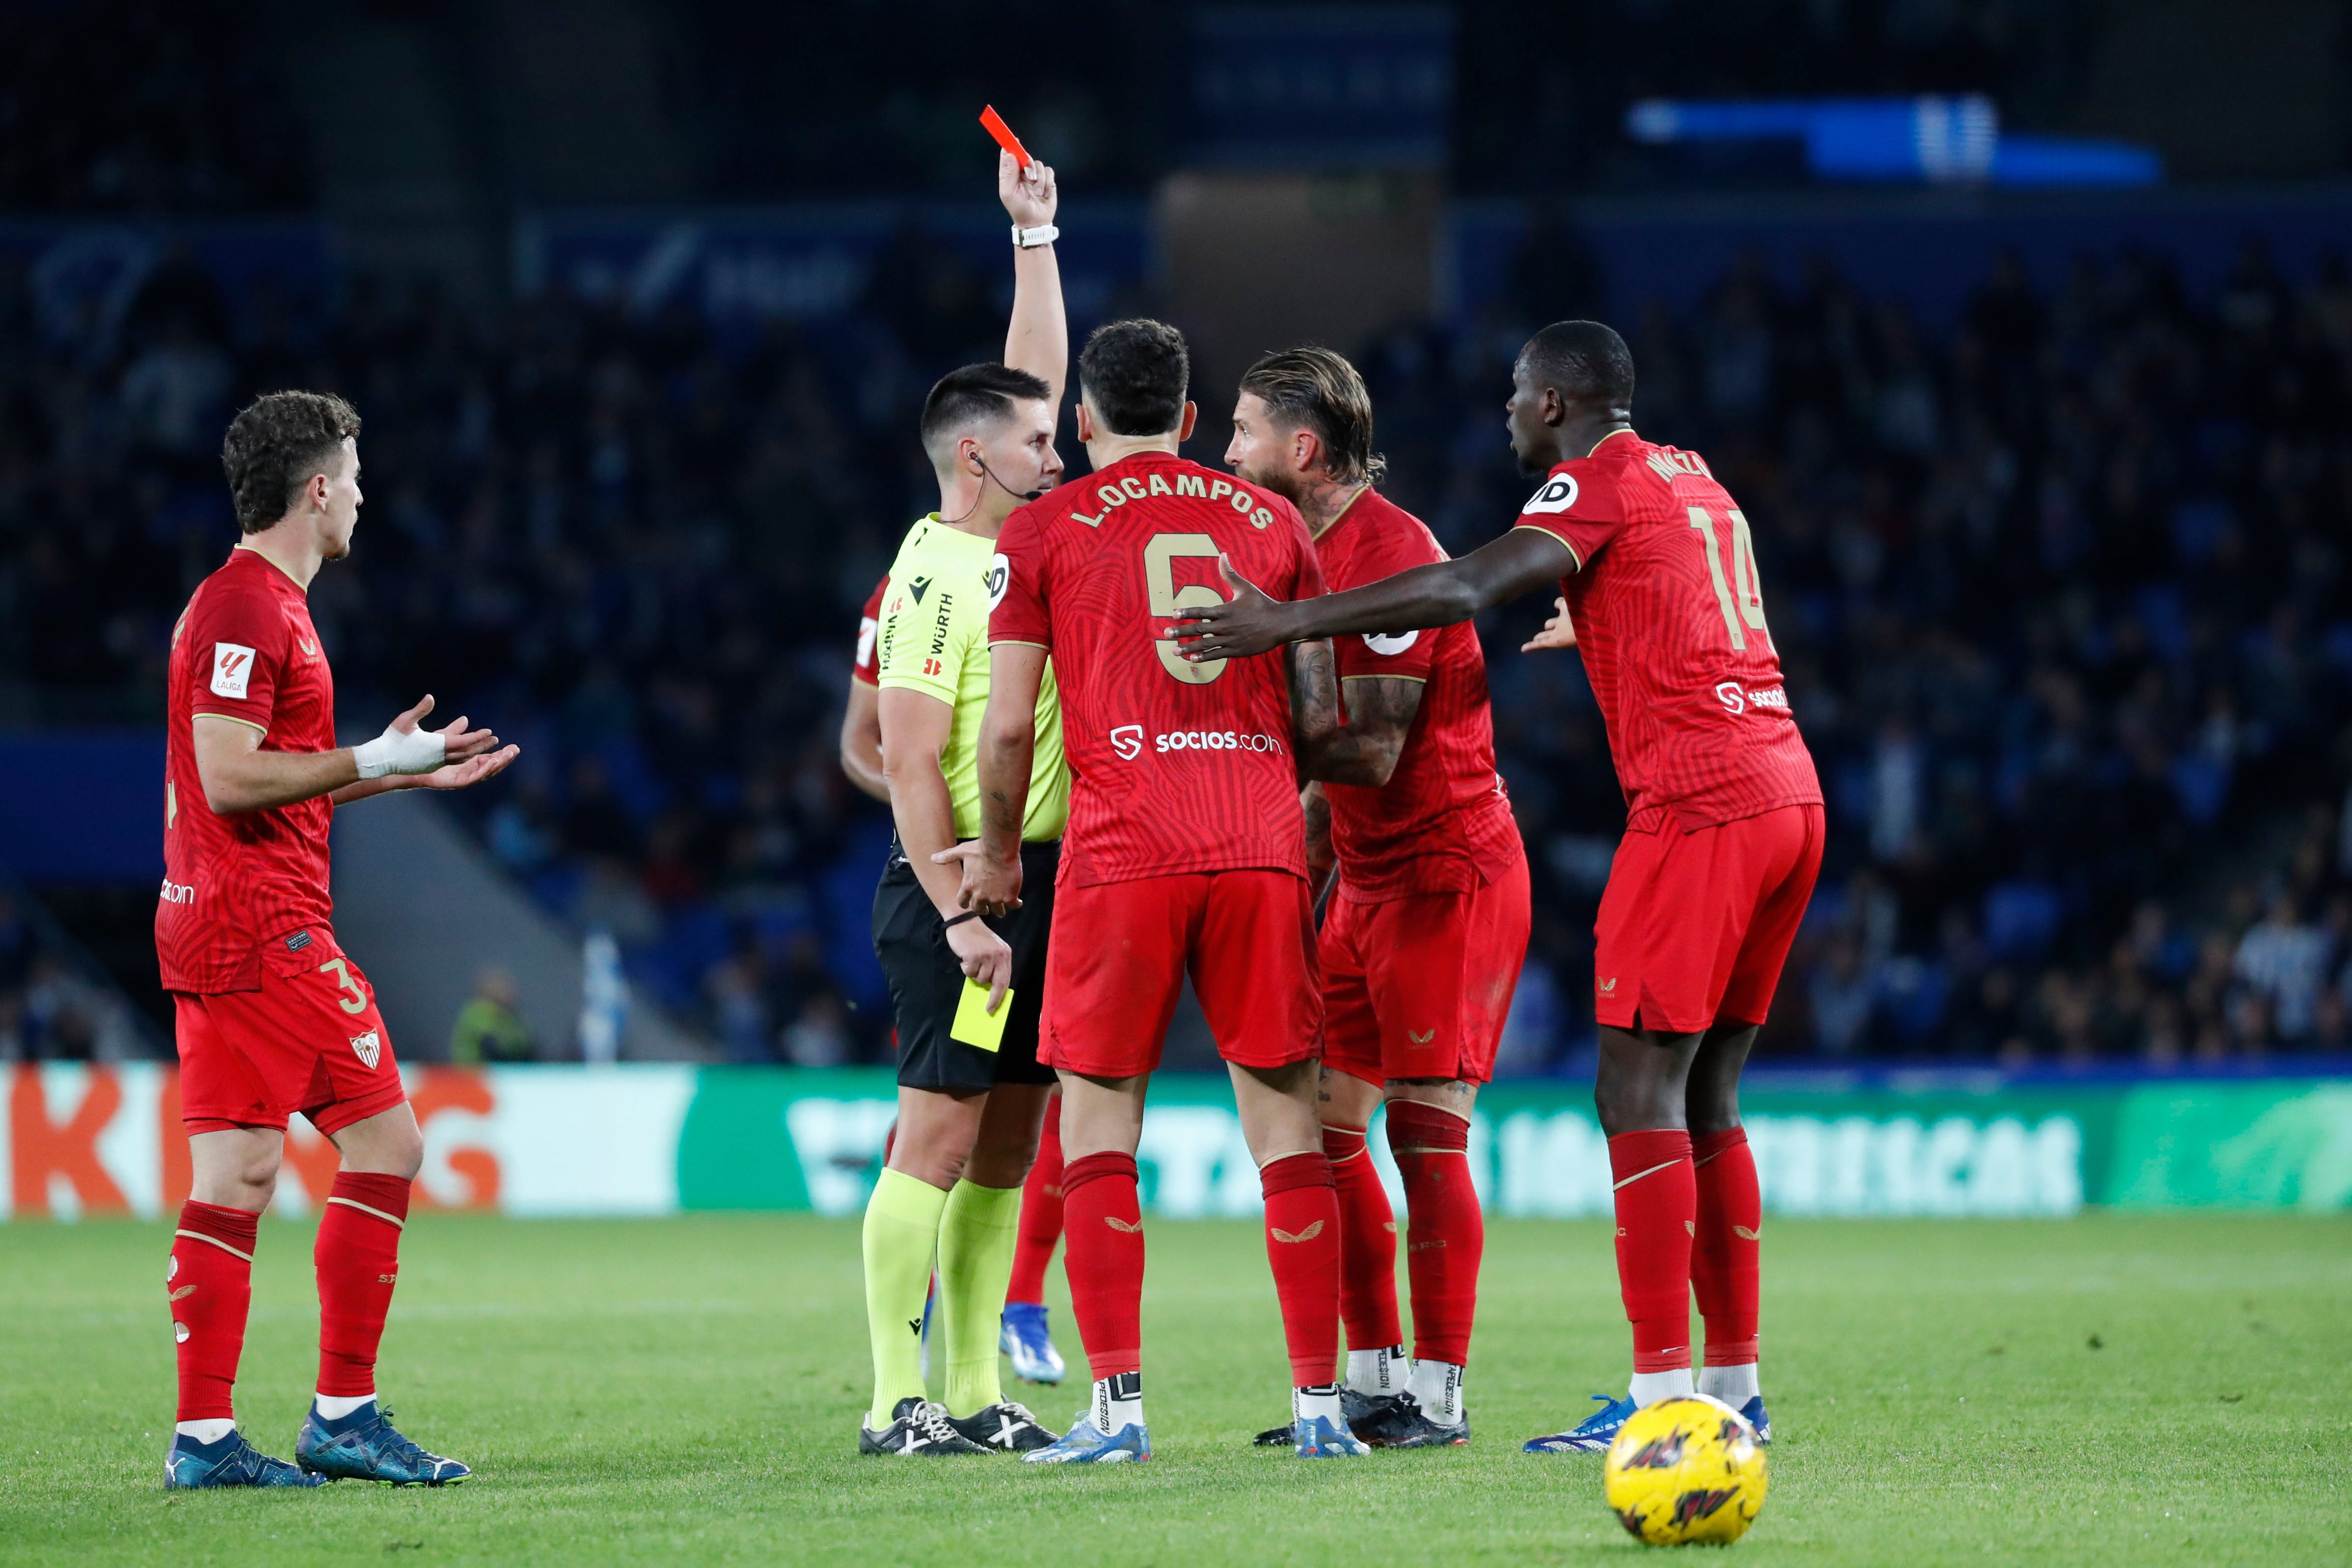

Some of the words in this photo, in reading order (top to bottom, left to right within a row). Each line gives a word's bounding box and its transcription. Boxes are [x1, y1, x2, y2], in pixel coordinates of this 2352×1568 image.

[1069, 474, 1274, 530] L.OCAMPOS
[1143, 533, 1228, 684] 5
[1687, 506, 1778, 655] 14
[931, 593, 953, 654] WÜRTH
[216, 680, 242, 692] LALIGA
[319, 957, 368, 1014] 3
[10, 1064, 502, 1213] KIG
[1378, 1348, 1390, 1389] PEDESIGN
[1098, 1379, 1110, 1435] PEDESIGN
